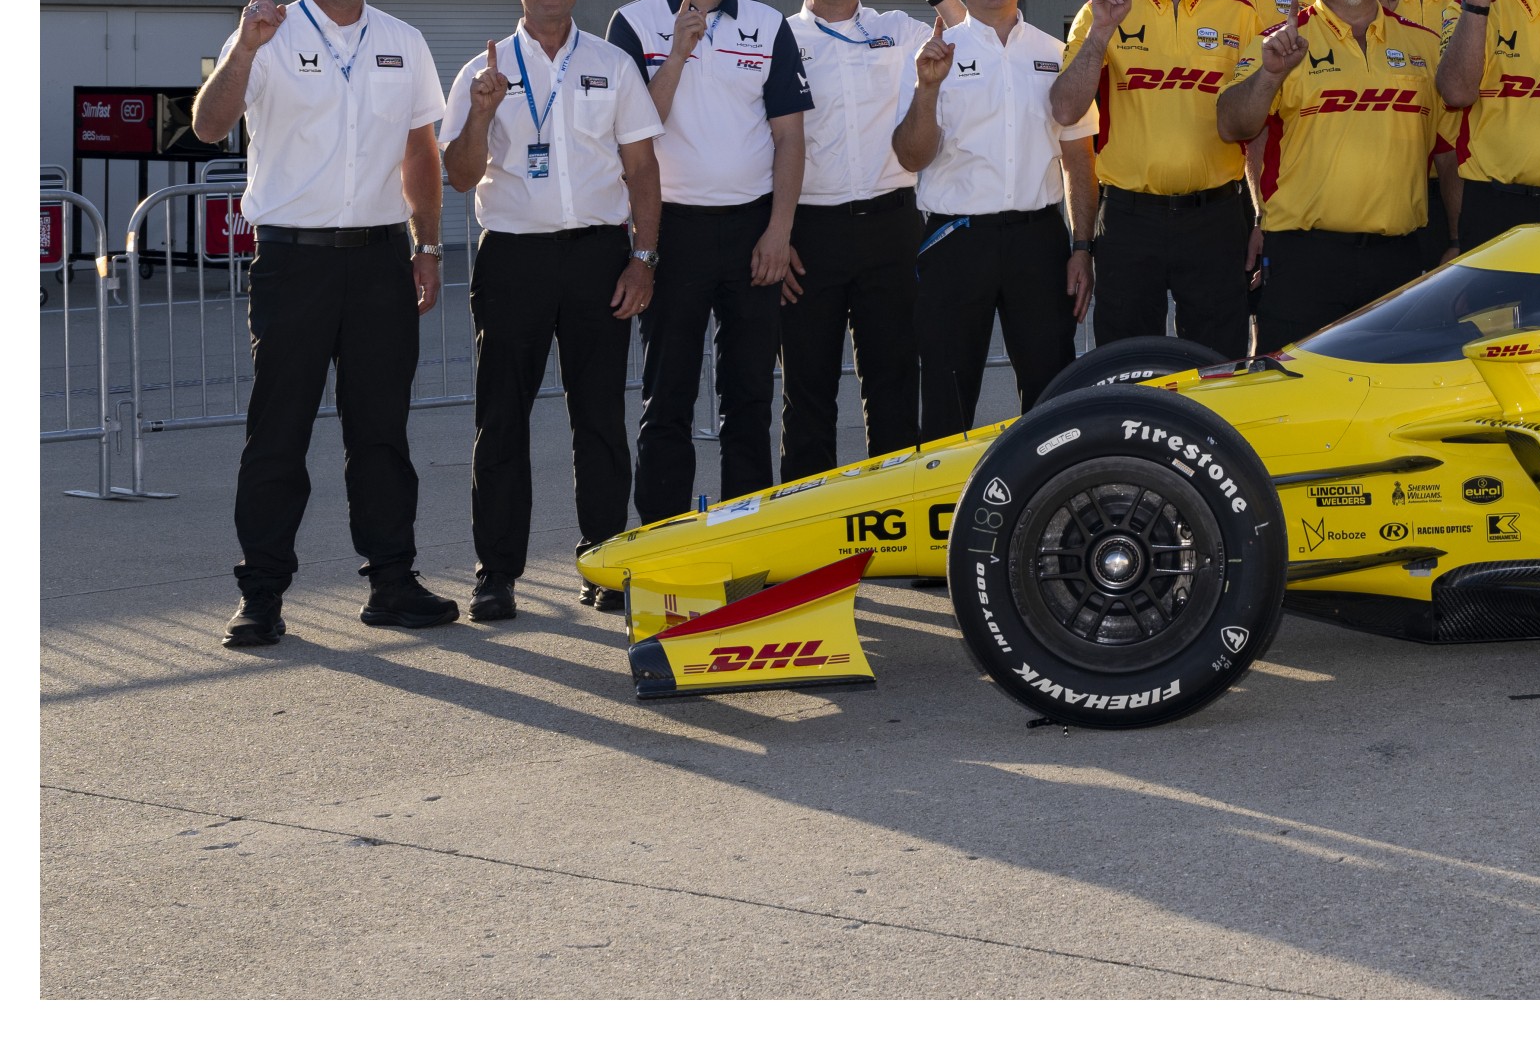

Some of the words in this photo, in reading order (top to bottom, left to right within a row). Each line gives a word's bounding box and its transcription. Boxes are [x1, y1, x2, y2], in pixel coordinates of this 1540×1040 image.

[736, 59, 764, 70] HRC
[1308, 67, 1341, 75] Honda
[1126, 67, 1224, 94] DHL
[1318, 88, 1422, 114] DHL
[1486, 344, 1533, 358] DHL
[1039, 430, 1078, 453] ENLITEN
[1121, 420, 1248, 513] Firestone
[1310, 486, 1360, 496] LINCOLN
[1408, 484, 1440, 492] SHERWIN
[1466, 486, 1500, 496] eurol
[1322, 497, 1366, 506] WELDERS
[843, 509, 907, 542] TRG
[1417, 526, 1445, 534] RACING
[1446, 526, 1472, 534] OPTICS
[1328, 530, 1366, 540] Roboze
[880, 545, 908, 554] GROUP
[708, 640, 830, 672] DHL
[1012, 662, 1182, 710] FIREHAWK
